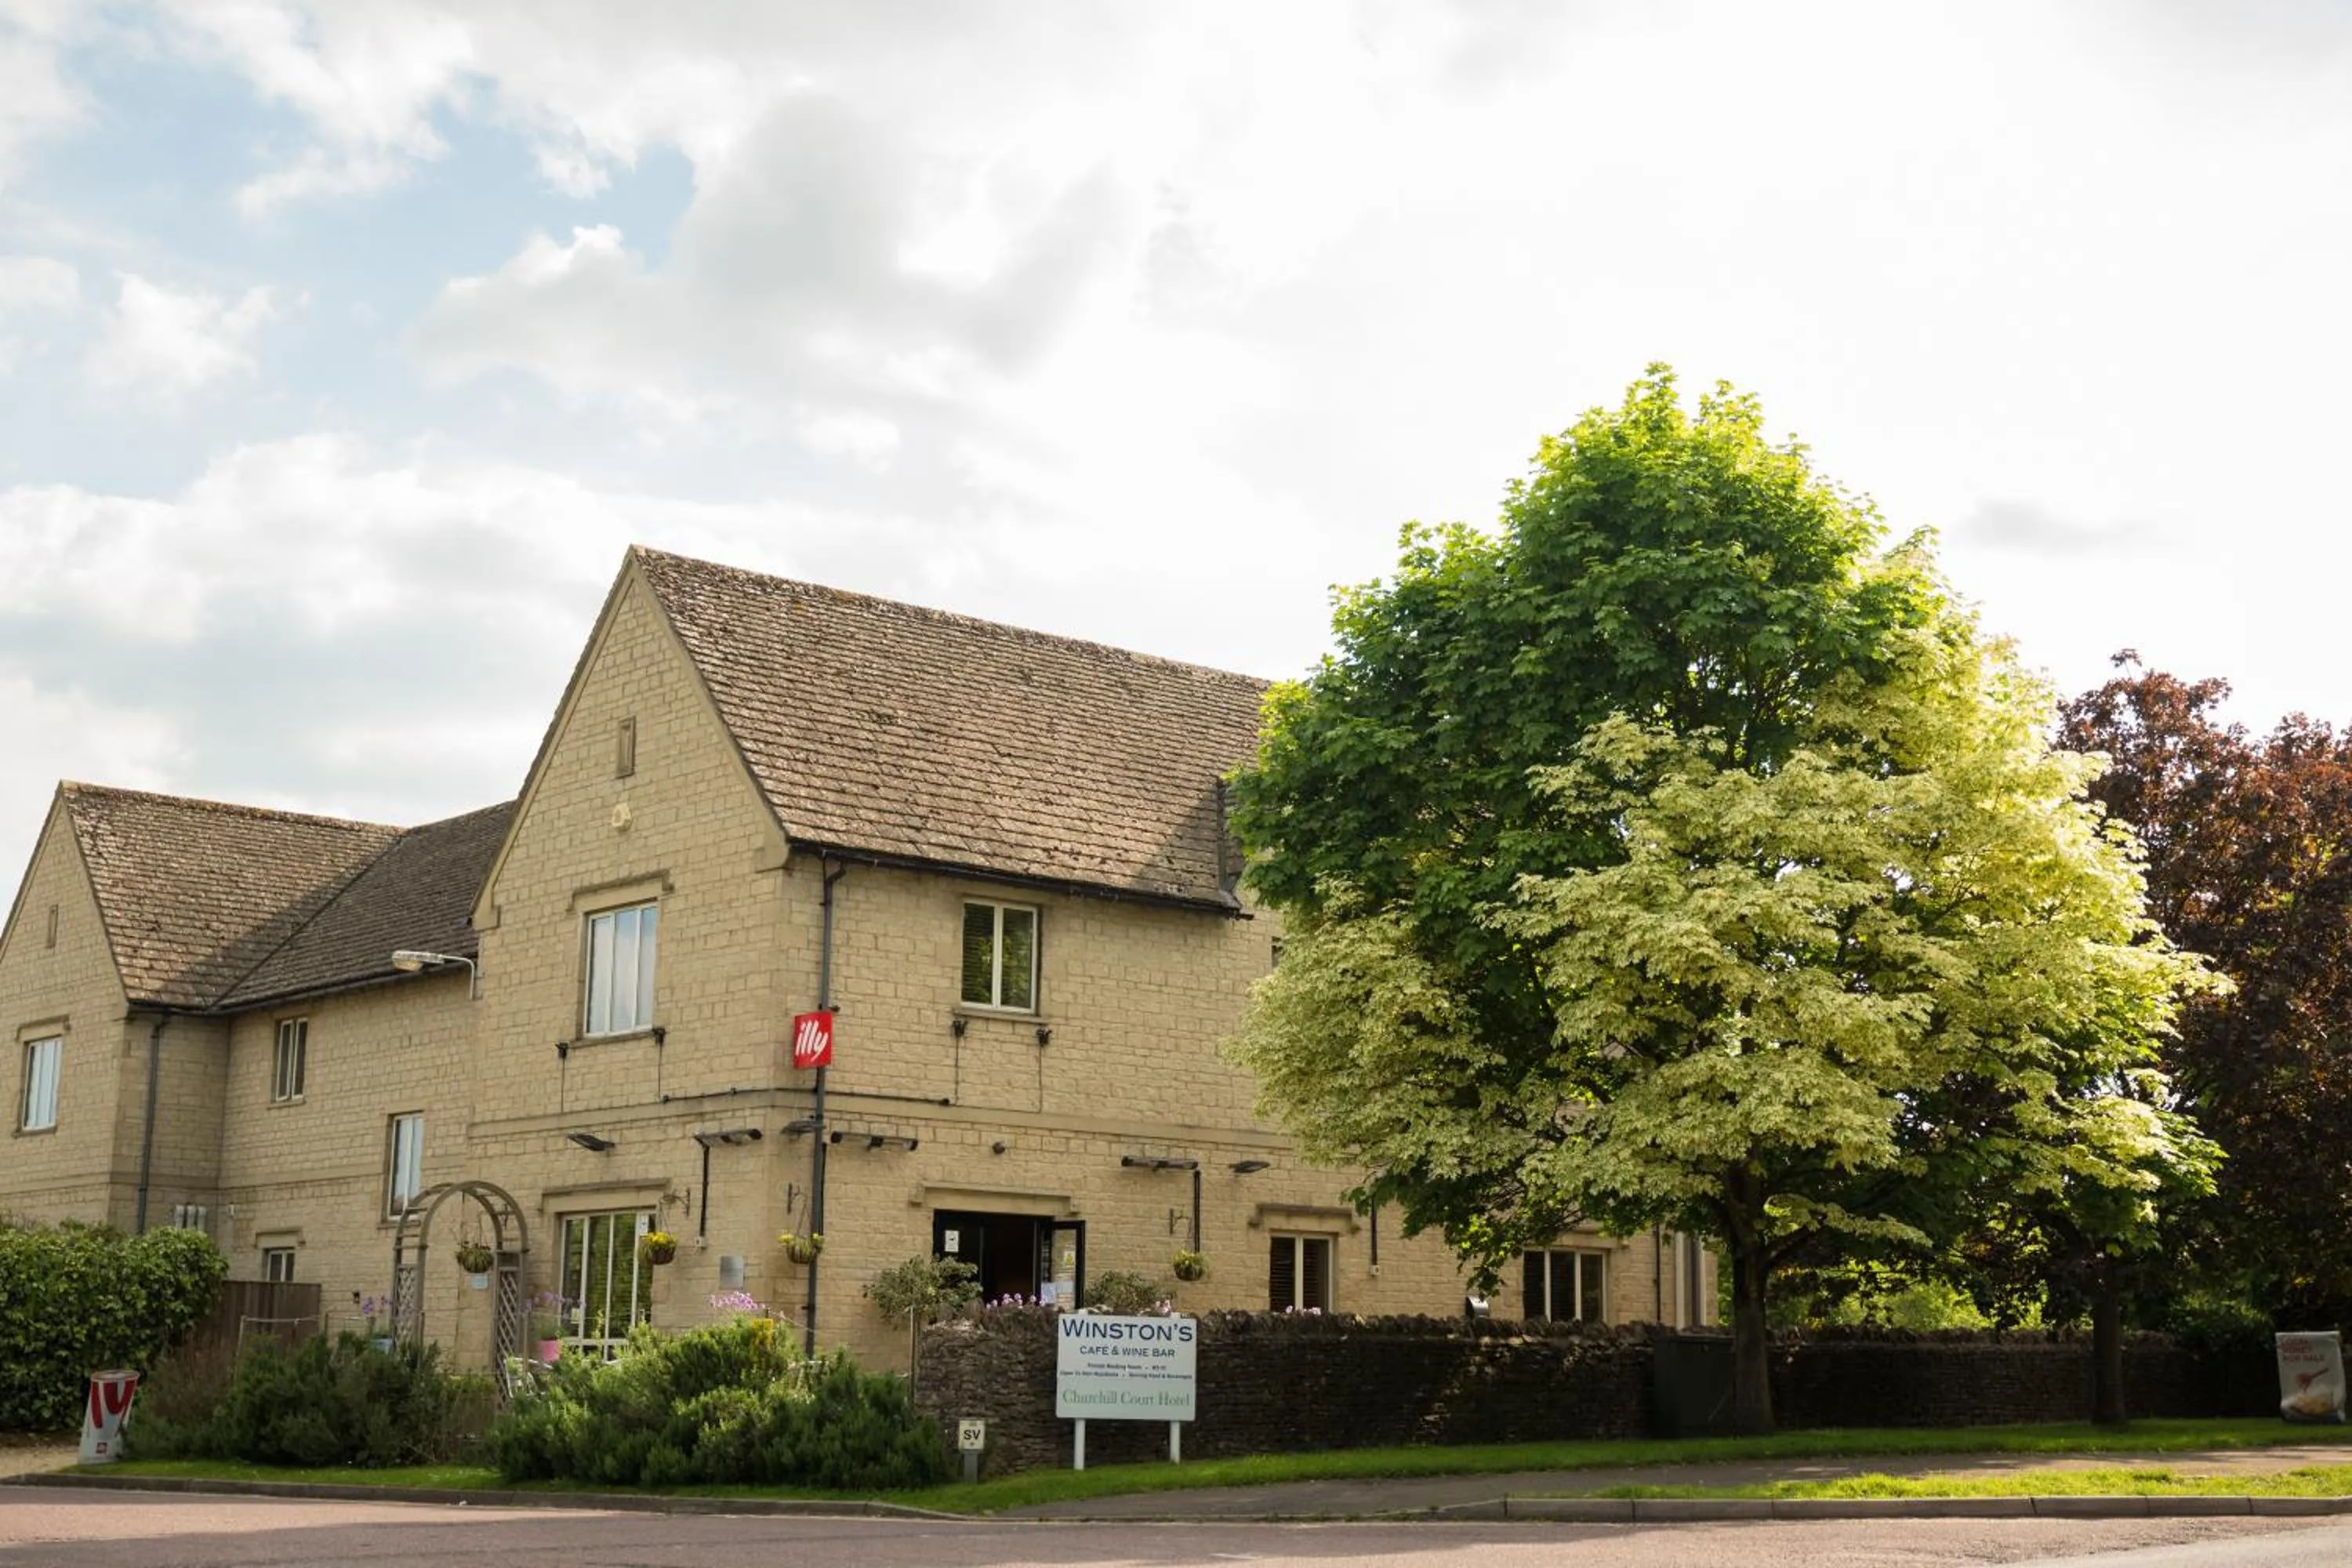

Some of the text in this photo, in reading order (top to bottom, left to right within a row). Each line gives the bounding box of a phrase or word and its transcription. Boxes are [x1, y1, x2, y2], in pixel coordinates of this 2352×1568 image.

[795, 1020, 829, 1062] illy
[1062, 1318, 1192, 1342] WINSTON'S
[1111, 1346, 1120, 1356] &
[1122, 1347, 1149, 1356] WINE
[1152, 1348, 1175, 1358] BAR
[1062, 1388, 1190, 1406] Churchill Court Hotel
[964, 1429, 981, 1440] SV
